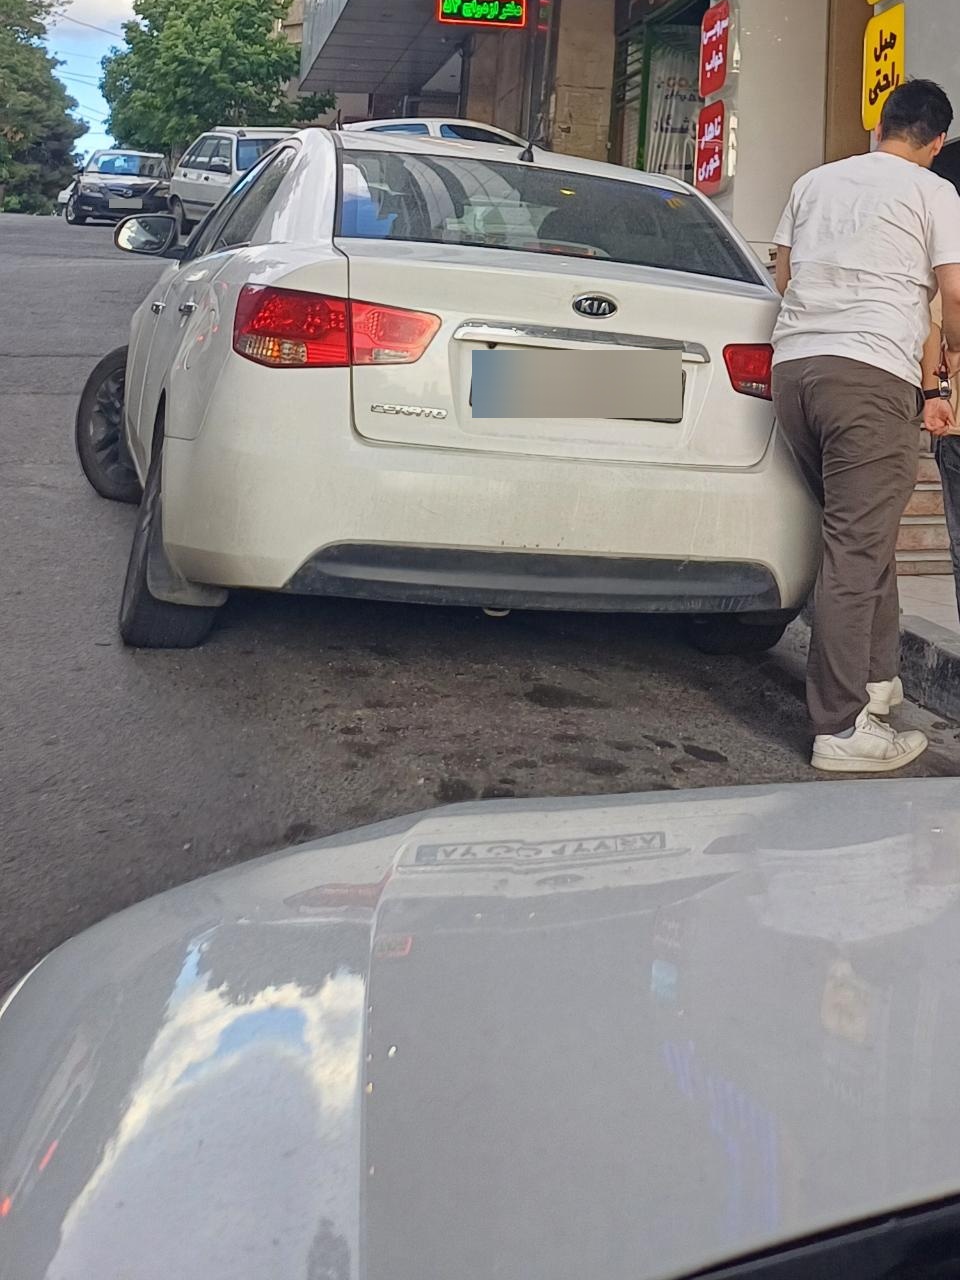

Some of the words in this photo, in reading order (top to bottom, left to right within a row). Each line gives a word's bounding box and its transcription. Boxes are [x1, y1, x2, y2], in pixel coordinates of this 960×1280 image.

[462, 0, 499, 18] ازدواج
[498, 1, 523, 20] دفتر
[704, 44, 723, 78] خواب
[874, 30, 897, 62] مبل
[868, 63, 900, 106] راحتی
[697, 146, 721, 180] خوری
[578, 299, 613, 314] KIA
